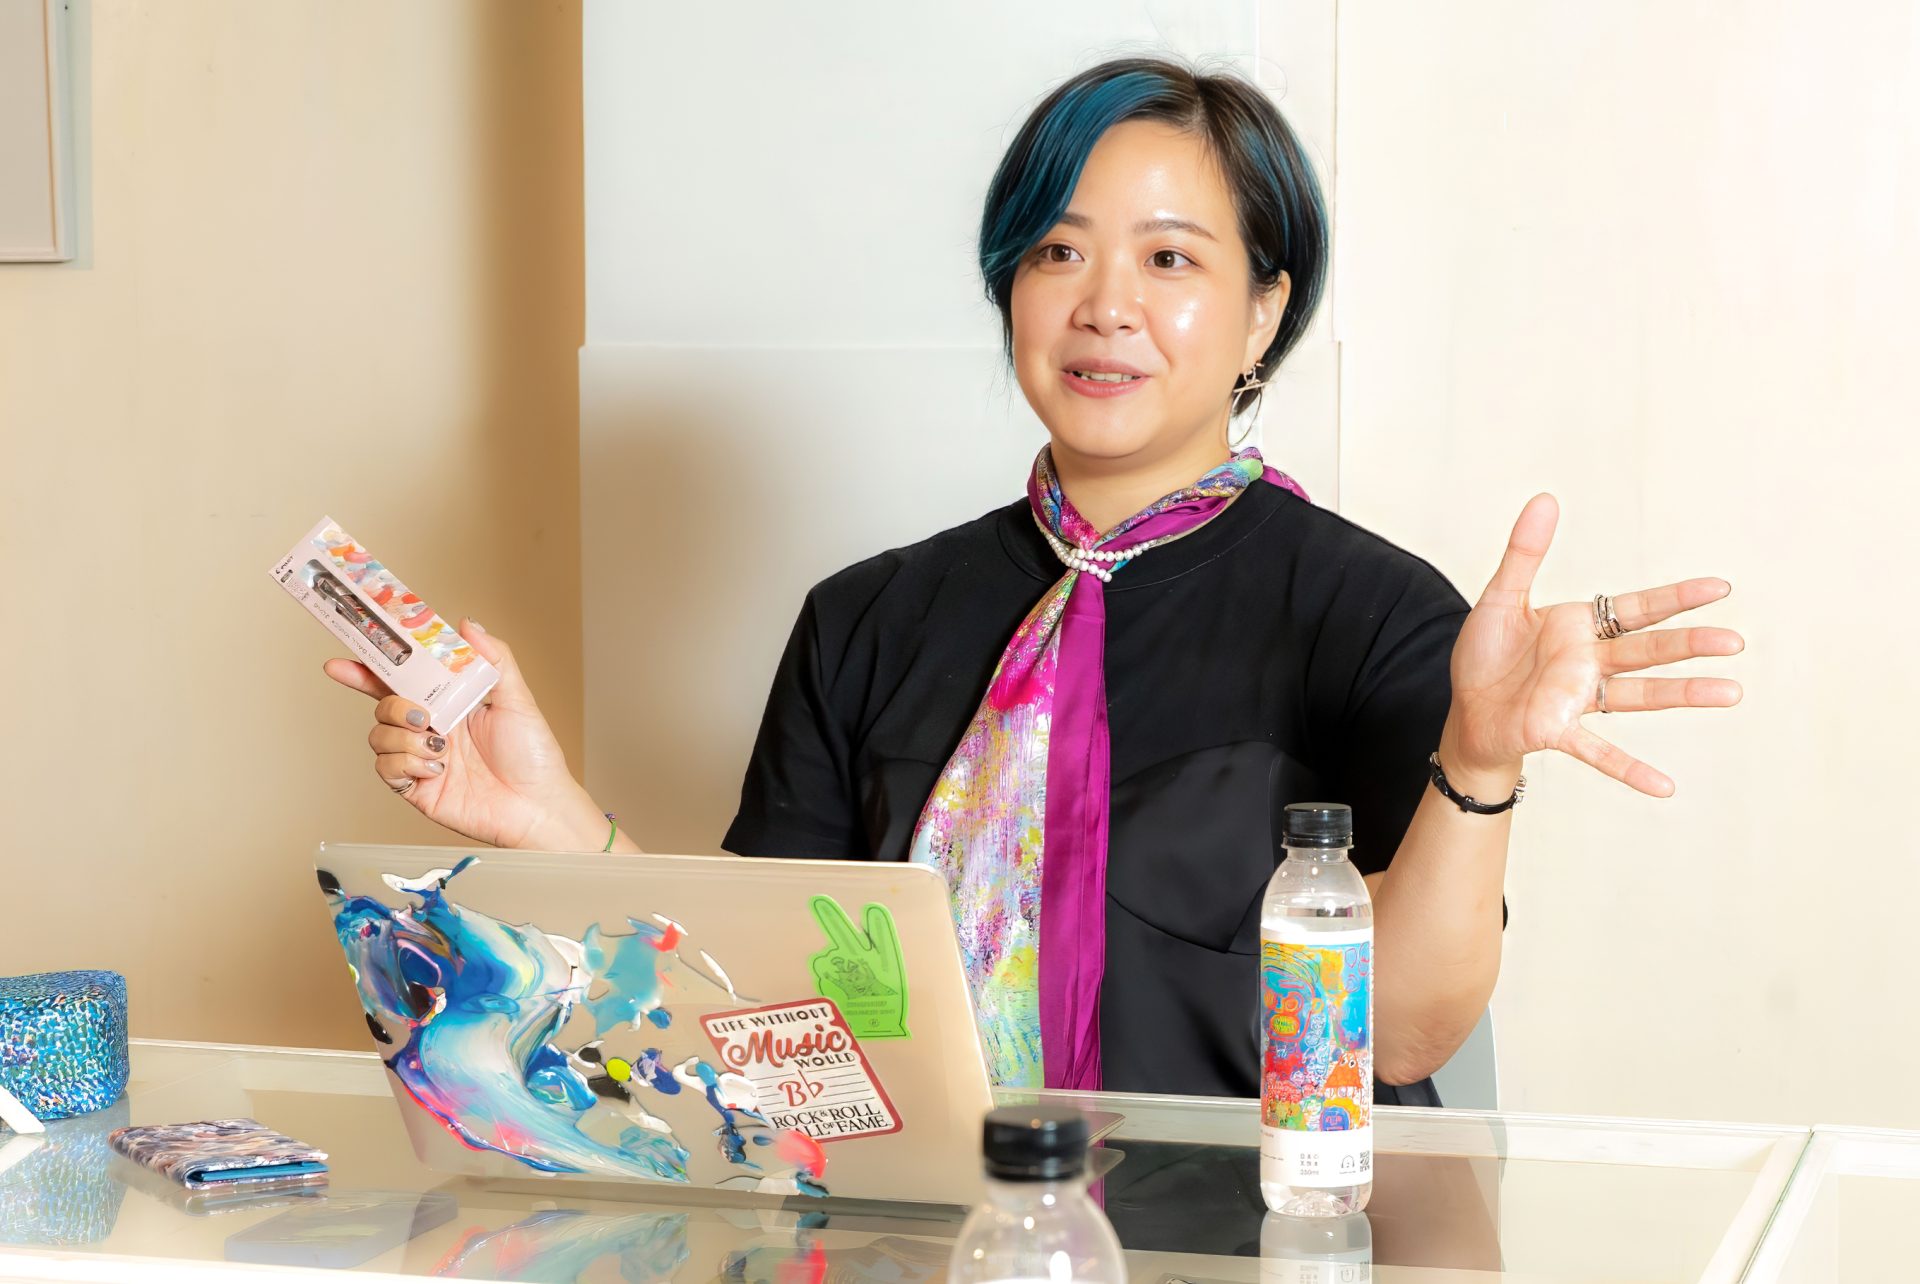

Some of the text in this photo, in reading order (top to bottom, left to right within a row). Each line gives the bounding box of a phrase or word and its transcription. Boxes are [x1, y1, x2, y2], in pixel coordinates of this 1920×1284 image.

[712, 1006, 829, 1034] LIFE WITHOUT
[727, 1023, 847, 1068] Music
[794, 1052, 856, 1069] WOULD
[771, 1111, 823, 1128] ROCK
[828, 1103, 881, 1121] ROLL
[836, 1115, 888, 1133] FAME
